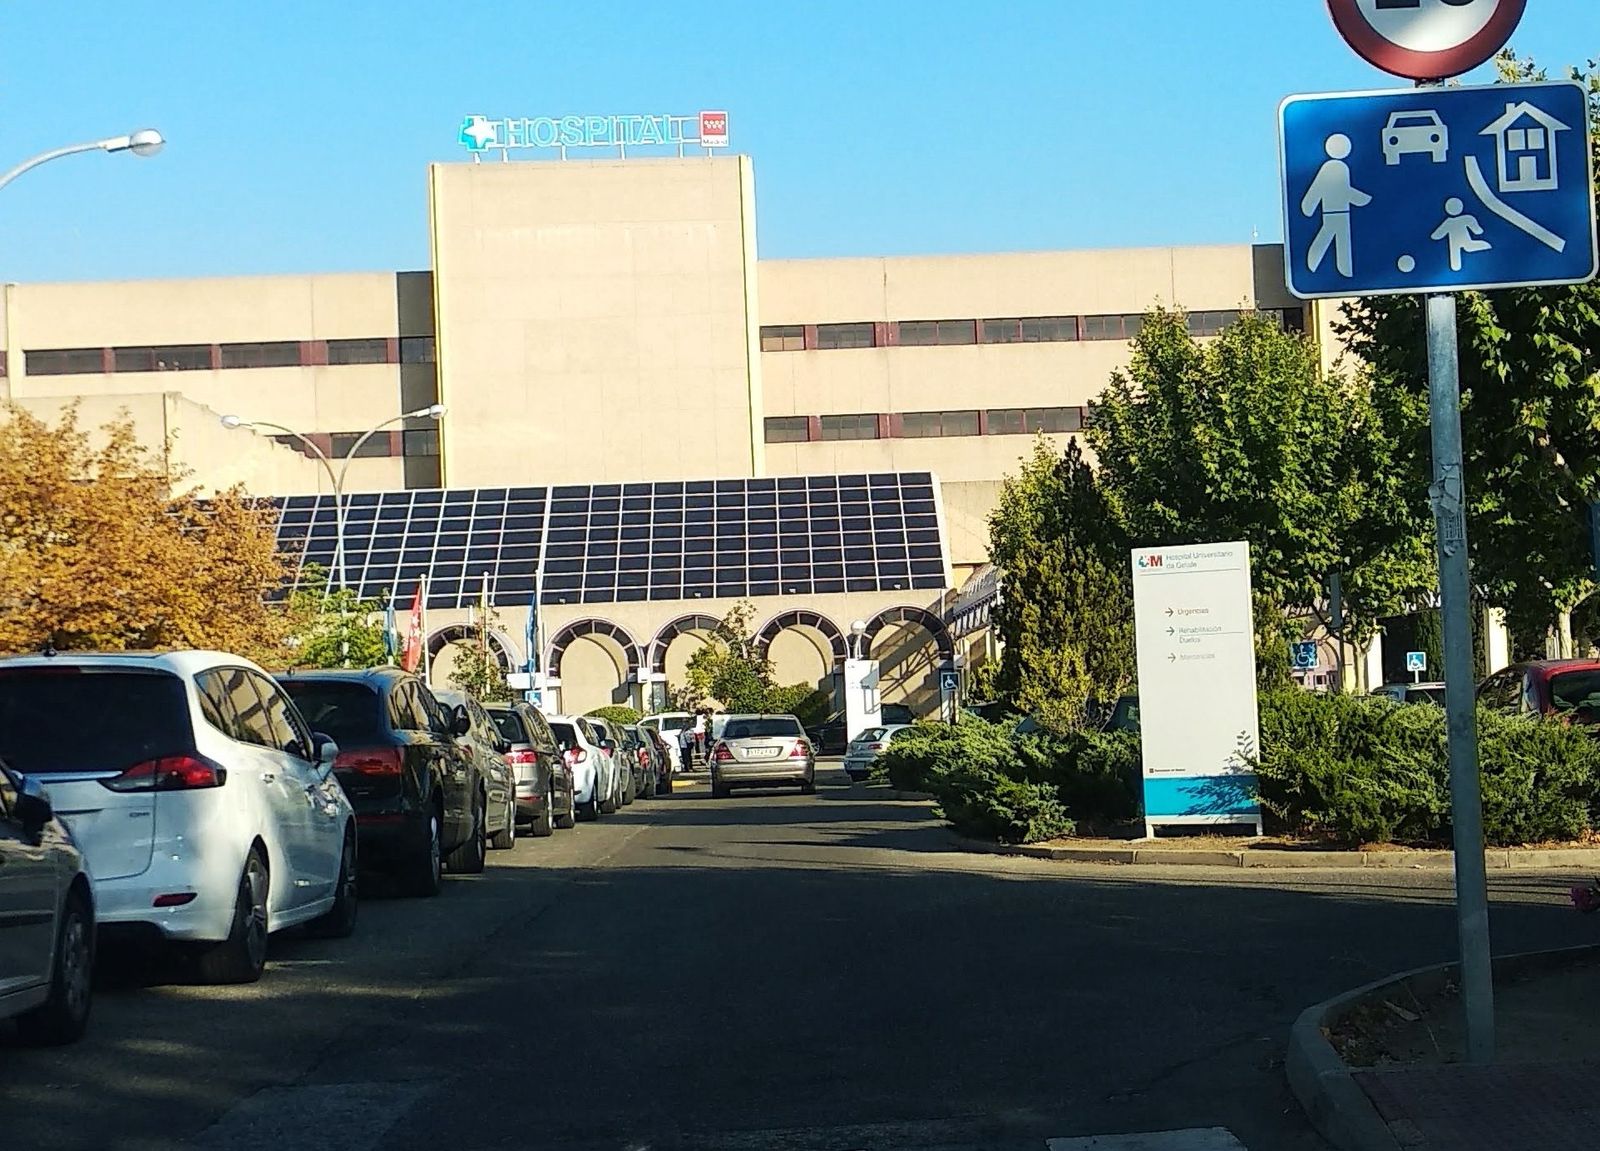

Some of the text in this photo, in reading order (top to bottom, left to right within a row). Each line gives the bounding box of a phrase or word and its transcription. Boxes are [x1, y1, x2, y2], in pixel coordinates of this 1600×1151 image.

[503, 114, 681, 148] HOSPITAL
[1166, 552, 1192, 561] Hospital
[1177, 608, 1209, 616] Urgencias
